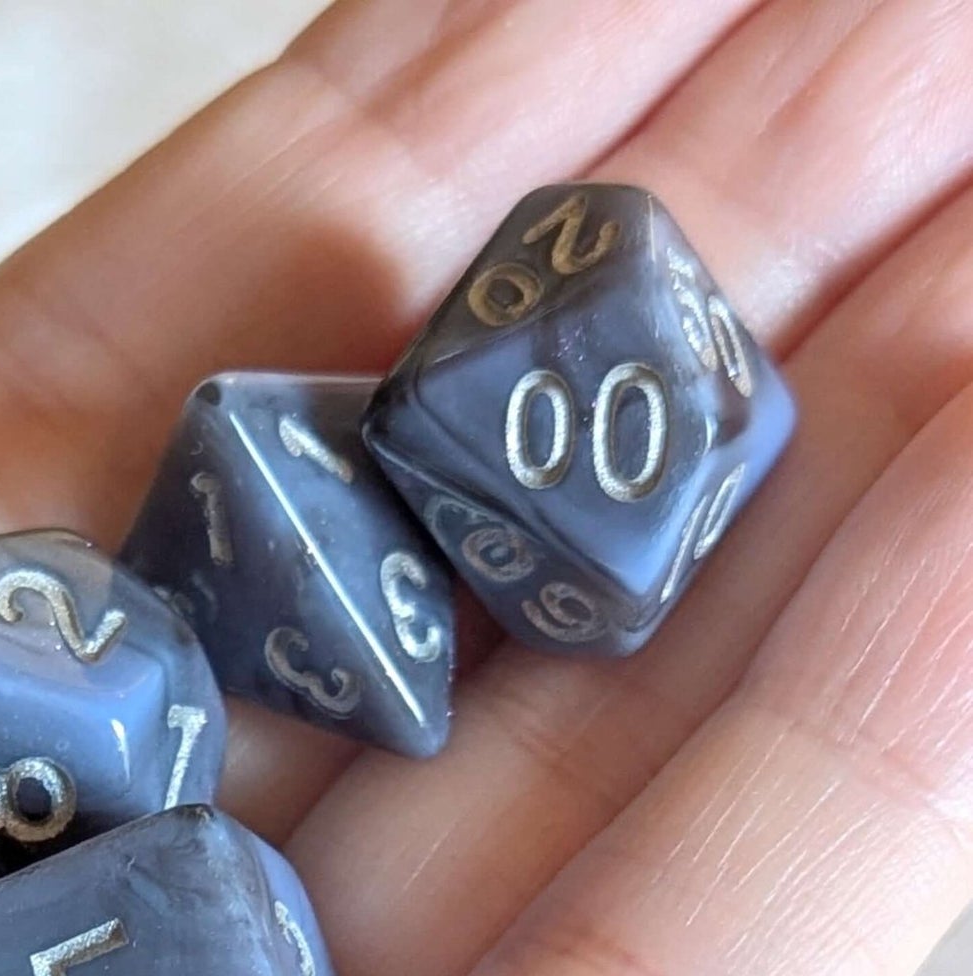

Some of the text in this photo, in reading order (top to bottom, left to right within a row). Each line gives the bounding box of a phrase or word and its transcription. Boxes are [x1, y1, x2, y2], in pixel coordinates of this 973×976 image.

[467, 195, 620, 329] 20
[505, 361, 668, 504] 00
[191, 471, 233, 566] 1
[380, 551, 441, 663] 3
[265, 626, 363, 720] 3
